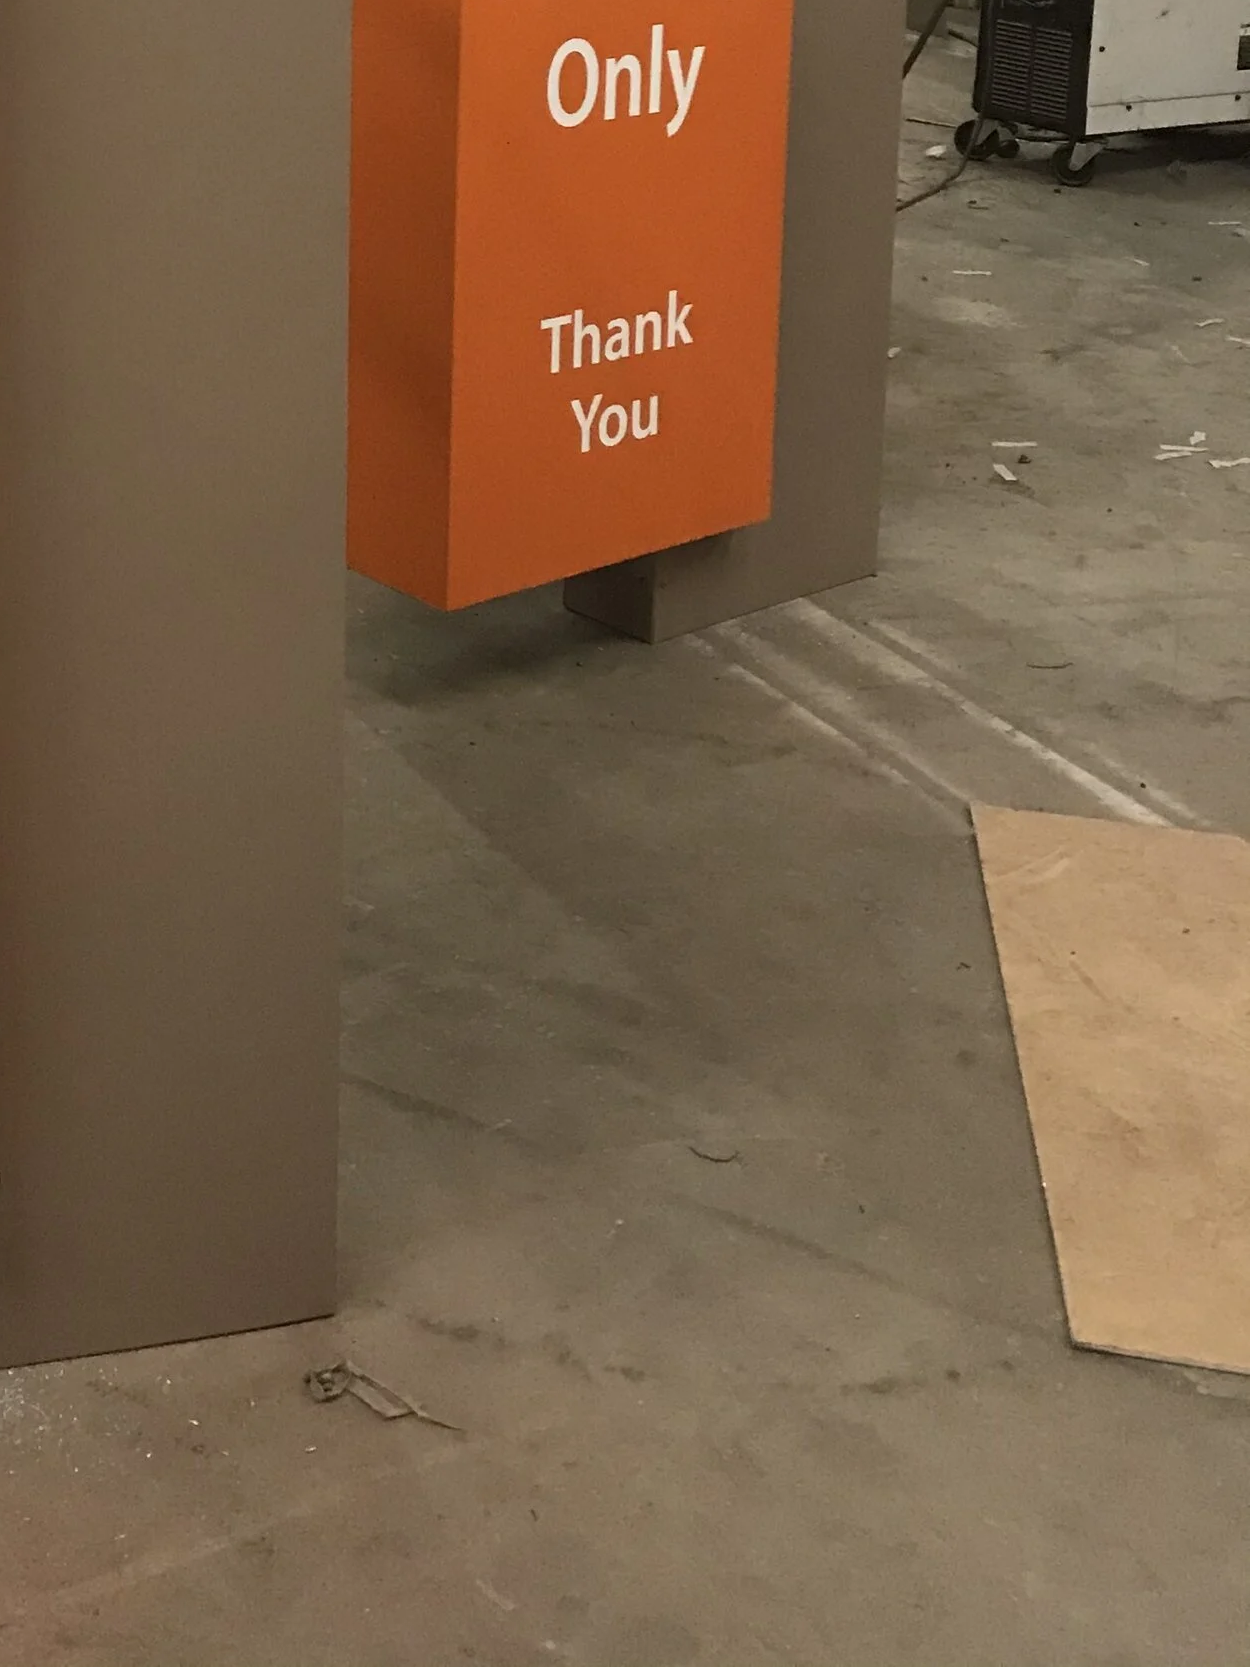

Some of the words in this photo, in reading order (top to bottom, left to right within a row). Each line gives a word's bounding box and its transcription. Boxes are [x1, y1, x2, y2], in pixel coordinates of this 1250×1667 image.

[547, 25, 705, 137] Only
[541, 290, 693, 374] Thank
[571, 395, 657, 452] You
